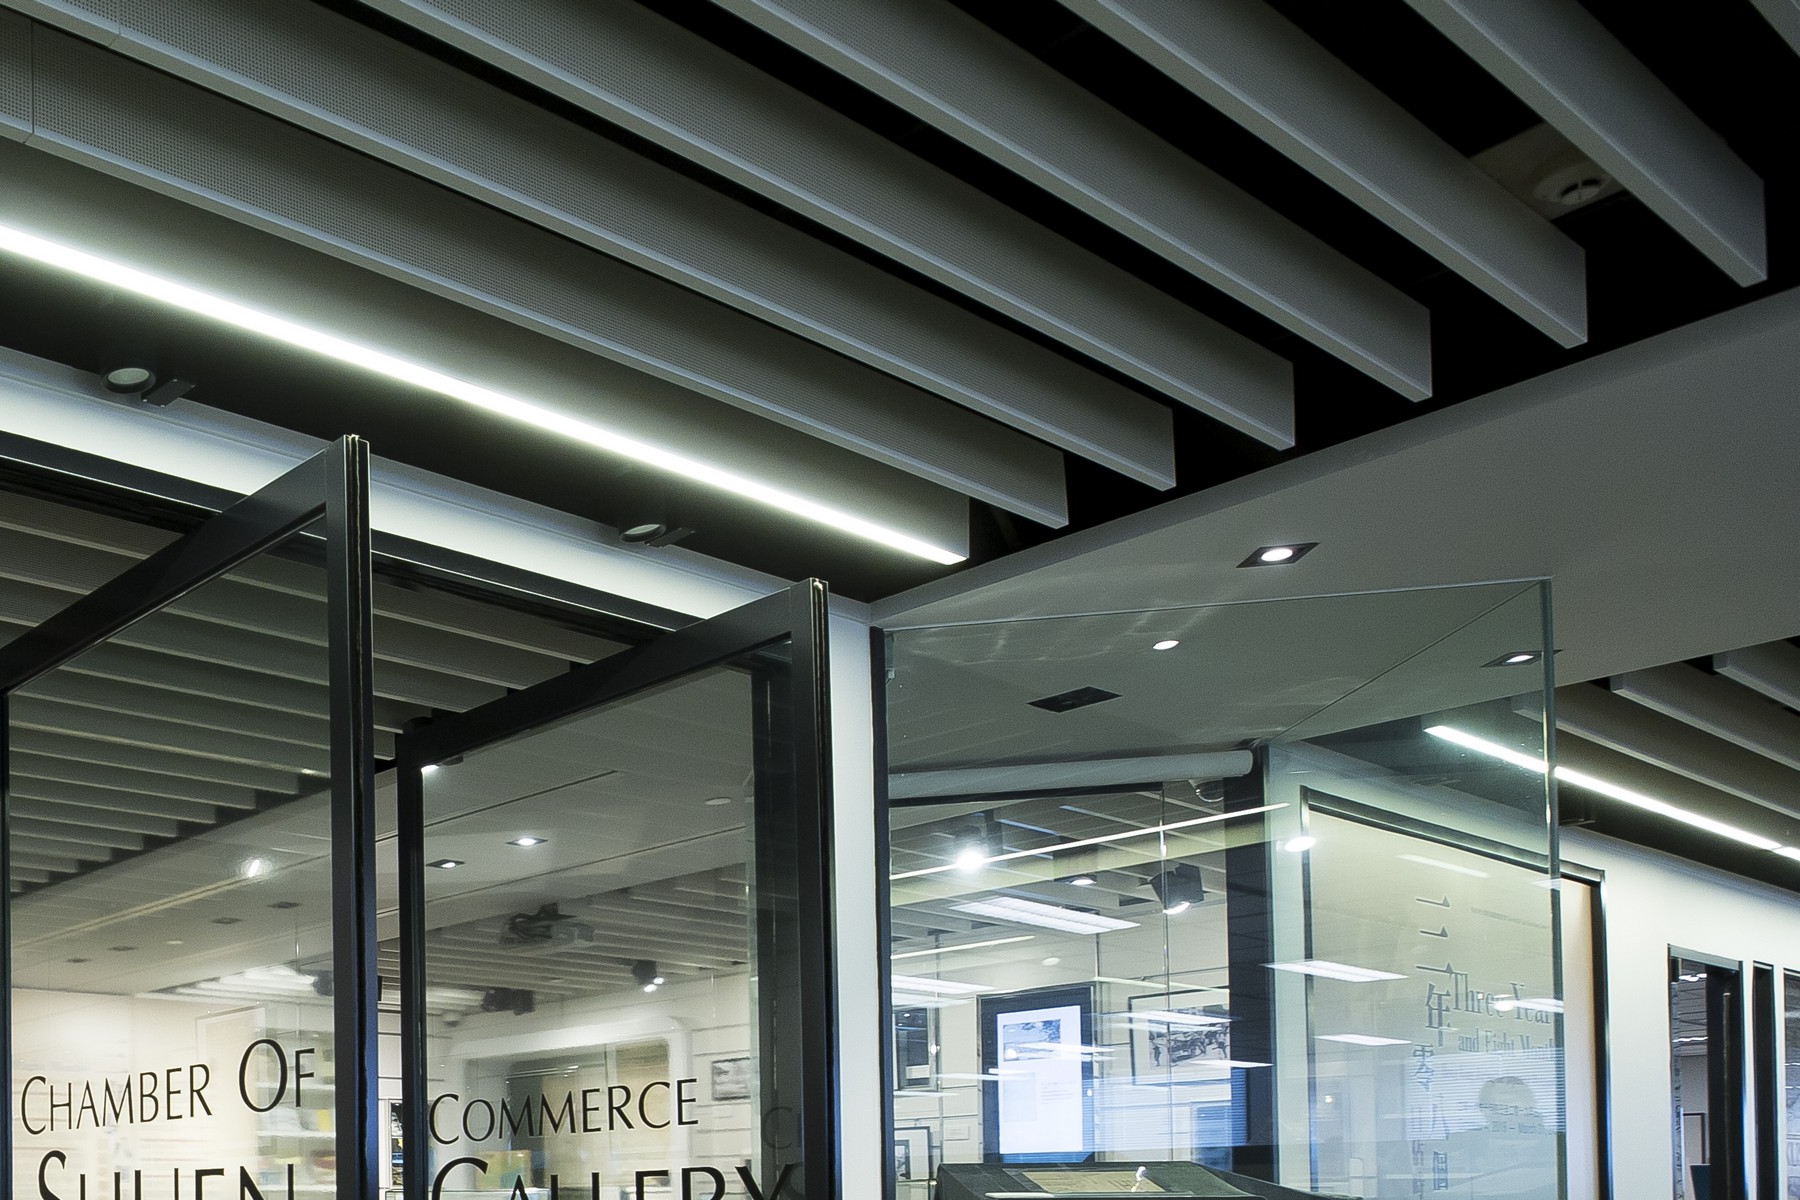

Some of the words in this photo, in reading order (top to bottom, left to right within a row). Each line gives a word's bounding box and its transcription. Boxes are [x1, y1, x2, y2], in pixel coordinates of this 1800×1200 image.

[1451, 971, 1507, 1018] Three
[21, 1063, 213, 1135] CHAMBER
[238, 1038, 316, 1113] OF
[429, 1078, 700, 1145] COMMERCE
